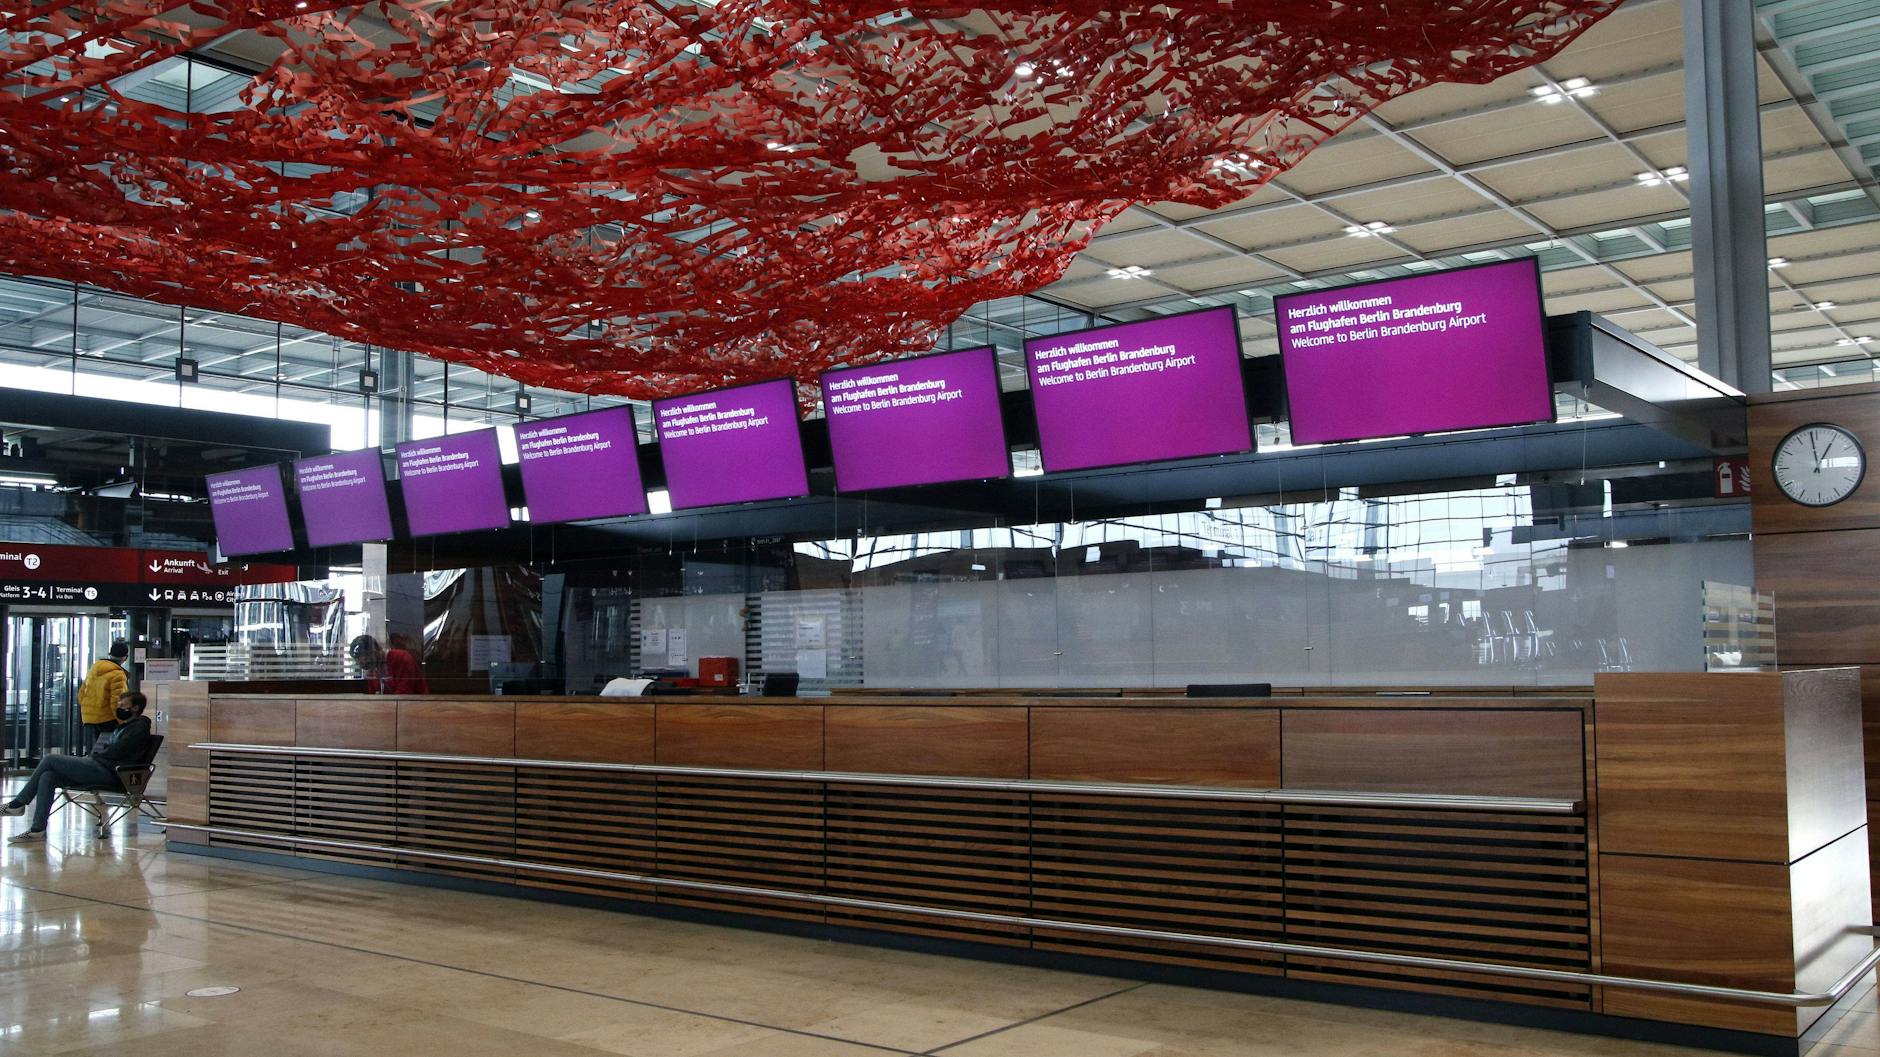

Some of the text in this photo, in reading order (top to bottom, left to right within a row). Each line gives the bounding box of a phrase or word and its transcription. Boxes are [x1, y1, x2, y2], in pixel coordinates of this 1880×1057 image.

[1288, 296, 1392, 319] Herzlich willkommen
[1290, 301, 1462, 334] am Flughafen Berlin Brandenburg
[1291, 312, 1486, 348] Welcome to Berlin Brandenburg Airport
[1035, 339, 1119, 360] Herzlich willkommen
[1037, 344, 1175, 373] am Flughafen Berlin Brandenburg
[1038, 354, 1195, 386] Welcome to Berlin Brandenburg Airport
[829, 373, 898, 391] Herzlich willkommen
[831, 379, 945, 403] am Flughafen Berlin Brandenburg
[660, 402, 716, 417] Herzlich willkommen
[832, 389, 962, 414] Welcome to Berlin Brandenburg Airport
[662, 407, 754, 428] am Flughafen Berlin Brandenburg
[663, 429, 687, 438] Welcome
[694, 424, 711, 434] Berlin
[711, 420, 747, 432] Brandenburg
[748, 416, 768, 427] Airport
[519, 427, 567, 439] Herzlich willkommen
[529, 439, 552, 449] Flughafen
[552, 436, 567, 445] Berlin
[567, 432, 599, 442] Brandenburg
[549, 447, 562, 456] Berlin
[563, 444, 593, 453] Brandenburg
[594, 440, 611, 450] Airport
[27, 558, 38, 566] T2
[164, 559, 195, 567] Ankunft
[22, 586, 46, 598] 3-4
